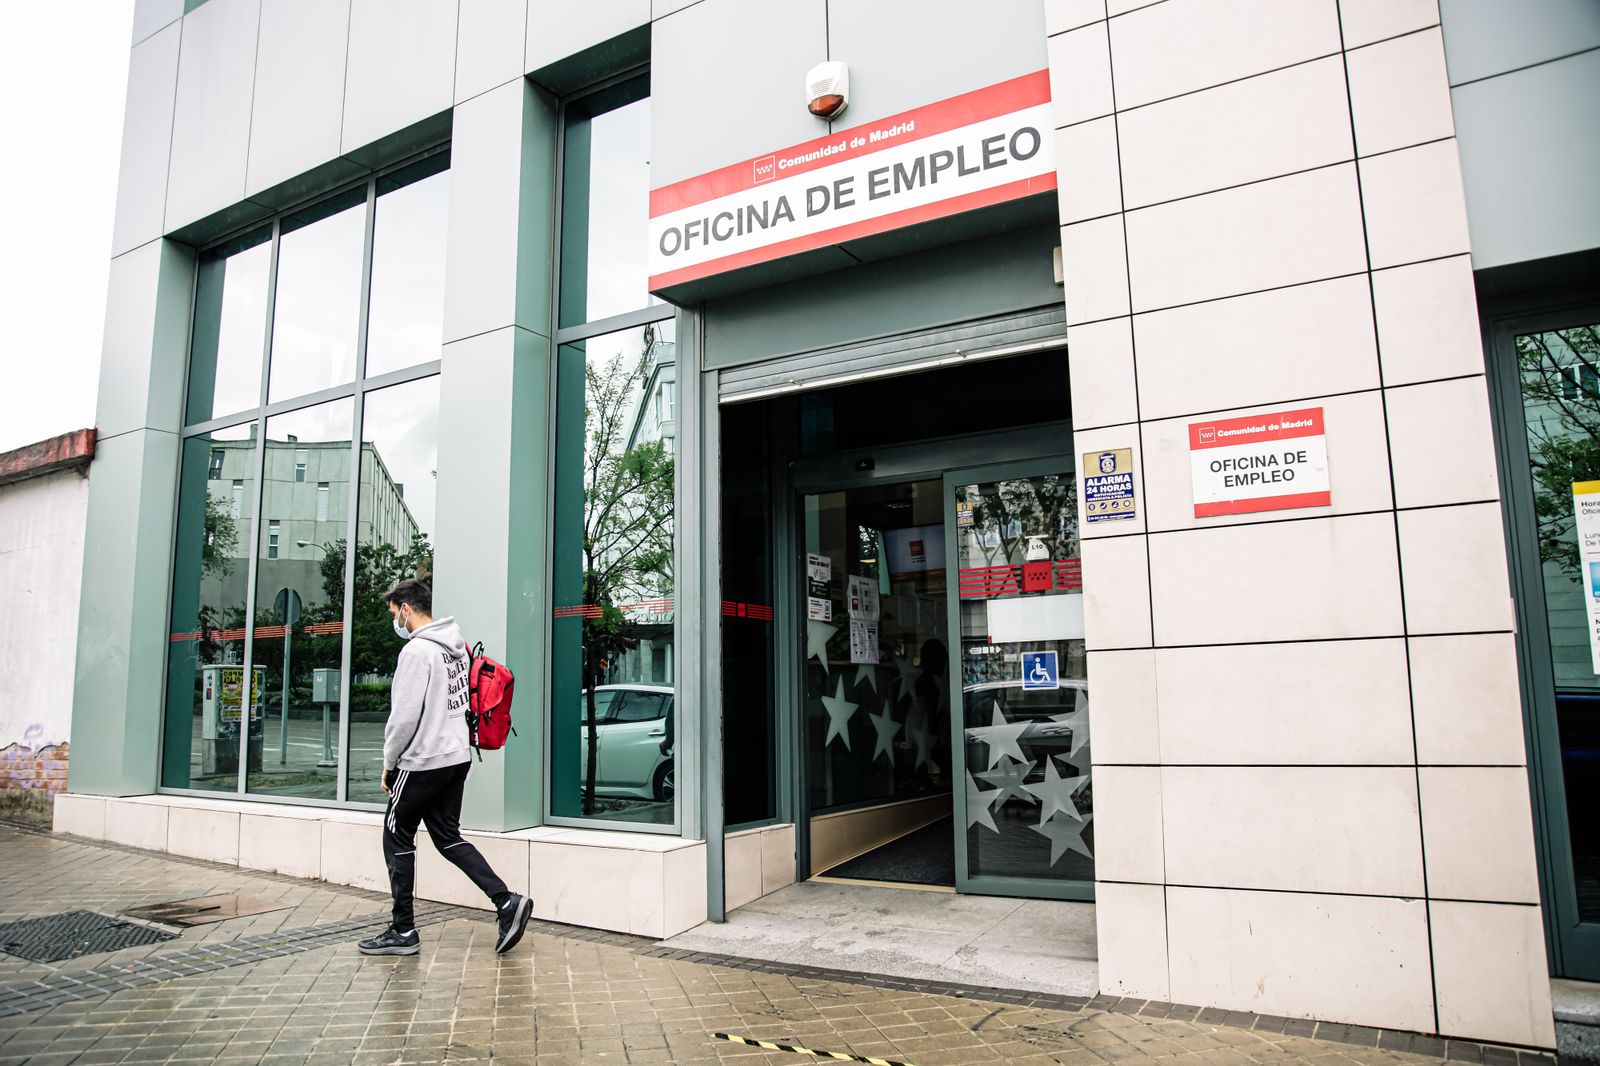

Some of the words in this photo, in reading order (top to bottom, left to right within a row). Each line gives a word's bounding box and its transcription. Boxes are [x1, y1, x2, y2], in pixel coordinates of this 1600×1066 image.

[778, 140, 847, 170] Comunidad
[850, 136, 866, 149] de
[869, 120, 915, 143] Madrid
[659, 195, 796, 257] OFICINA
[806, 176, 856, 217] DE
[868, 125, 1041, 201] EMPLEO
[1217, 424, 1266, 437] Comunidad
[1268, 422, 1279, 431] de
[1281, 418, 1313, 429] Madrid
[1210, 454, 1278, 473] OFICINA
[1284, 451, 1308, 464] DE
[1087, 474, 1131, 486] ALARMA
[1100, 483, 1132, 493] HORAS
[1224, 469, 1295, 488] EMPLEO
